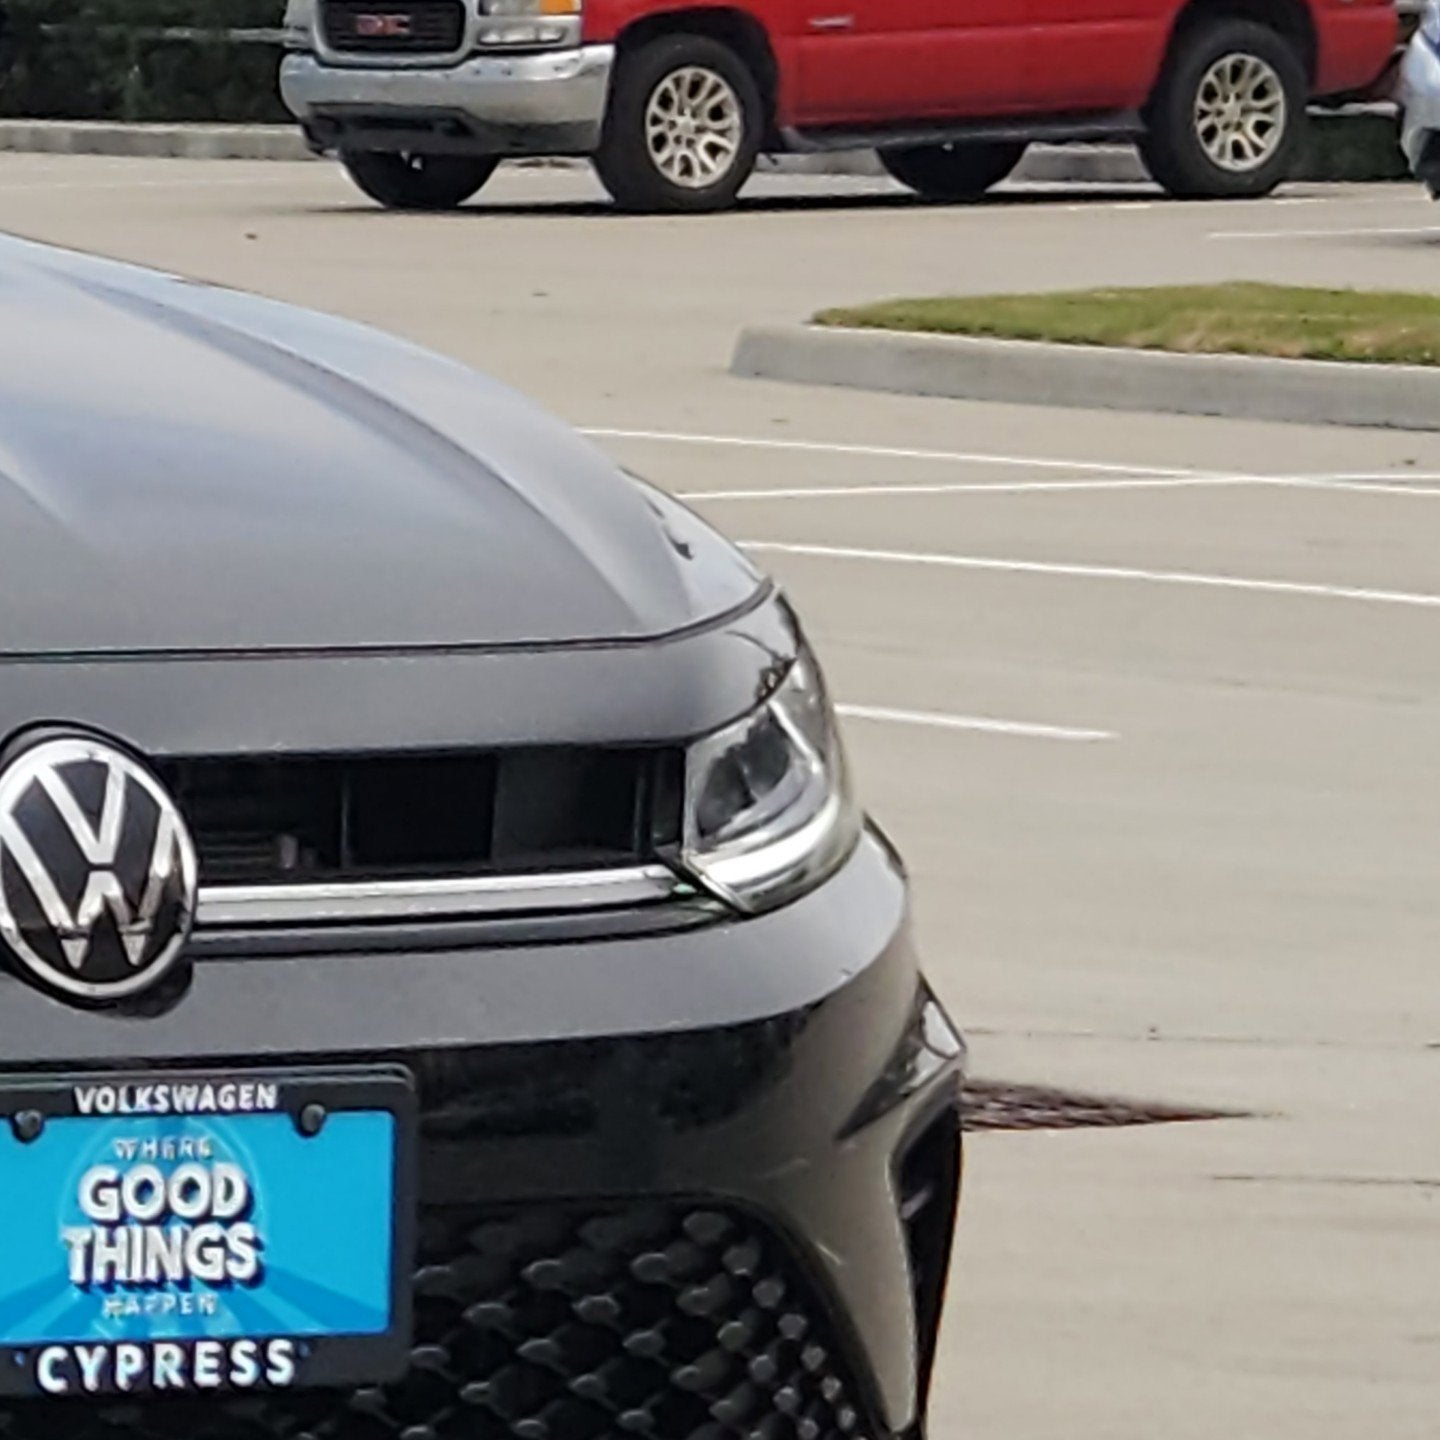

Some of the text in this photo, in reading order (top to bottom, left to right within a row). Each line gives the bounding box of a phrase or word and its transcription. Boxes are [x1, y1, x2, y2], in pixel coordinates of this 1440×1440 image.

[74, 1083, 278, 1114] VOLKSWAGEN
[114, 1136, 213, 1160] WHERE
[79, 1163, 250, 1222] GOOD
[62, 1221, 262, 1285] THINGS
[102, 1292, 218, 1317] HAPPEN
[36, 1338, 295, 1394] CYPRESS
